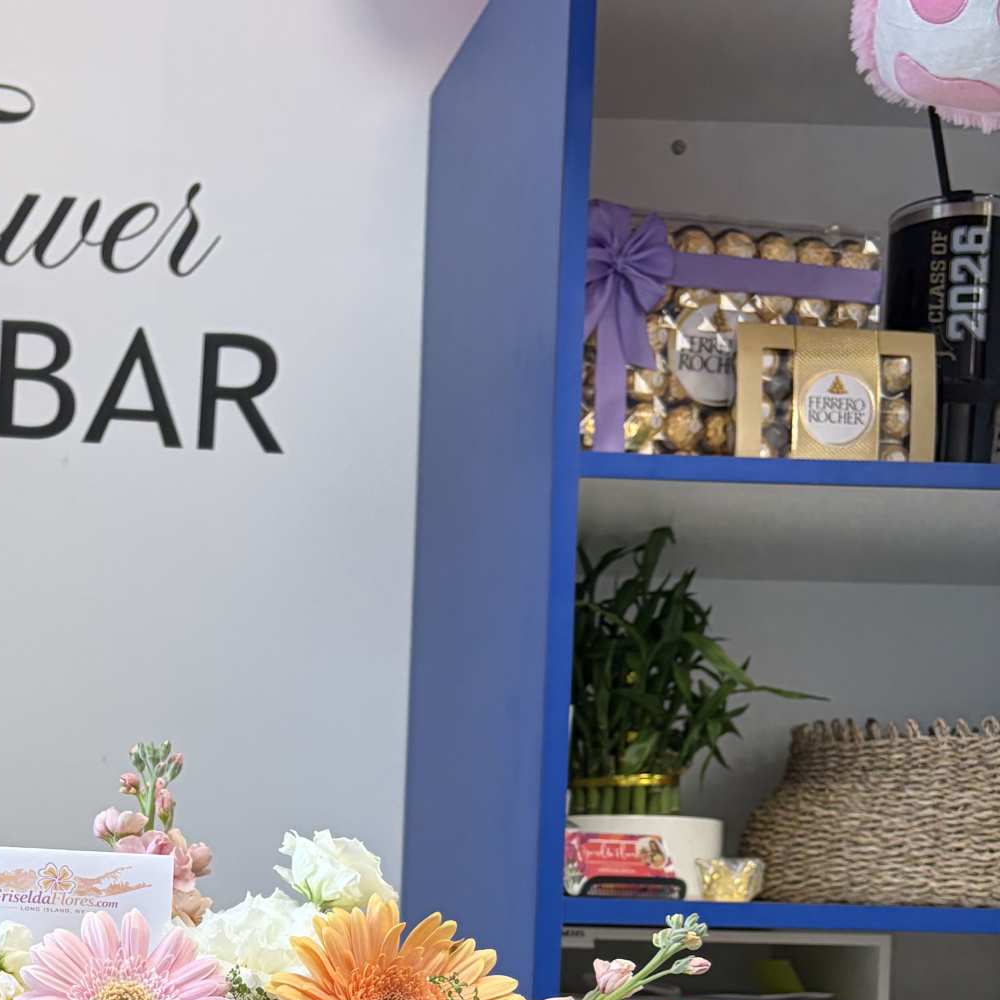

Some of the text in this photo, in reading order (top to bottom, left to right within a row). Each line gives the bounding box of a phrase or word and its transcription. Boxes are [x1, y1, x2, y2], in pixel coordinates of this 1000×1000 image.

[927, 230, 949, 324] CLASS OF
[947, 224, 991, 342] 2026
[807, 395, 866, 411] FERRERO
[807, 410, 866, 426] ROCHER
[20, 904, 41, 912] LONG
